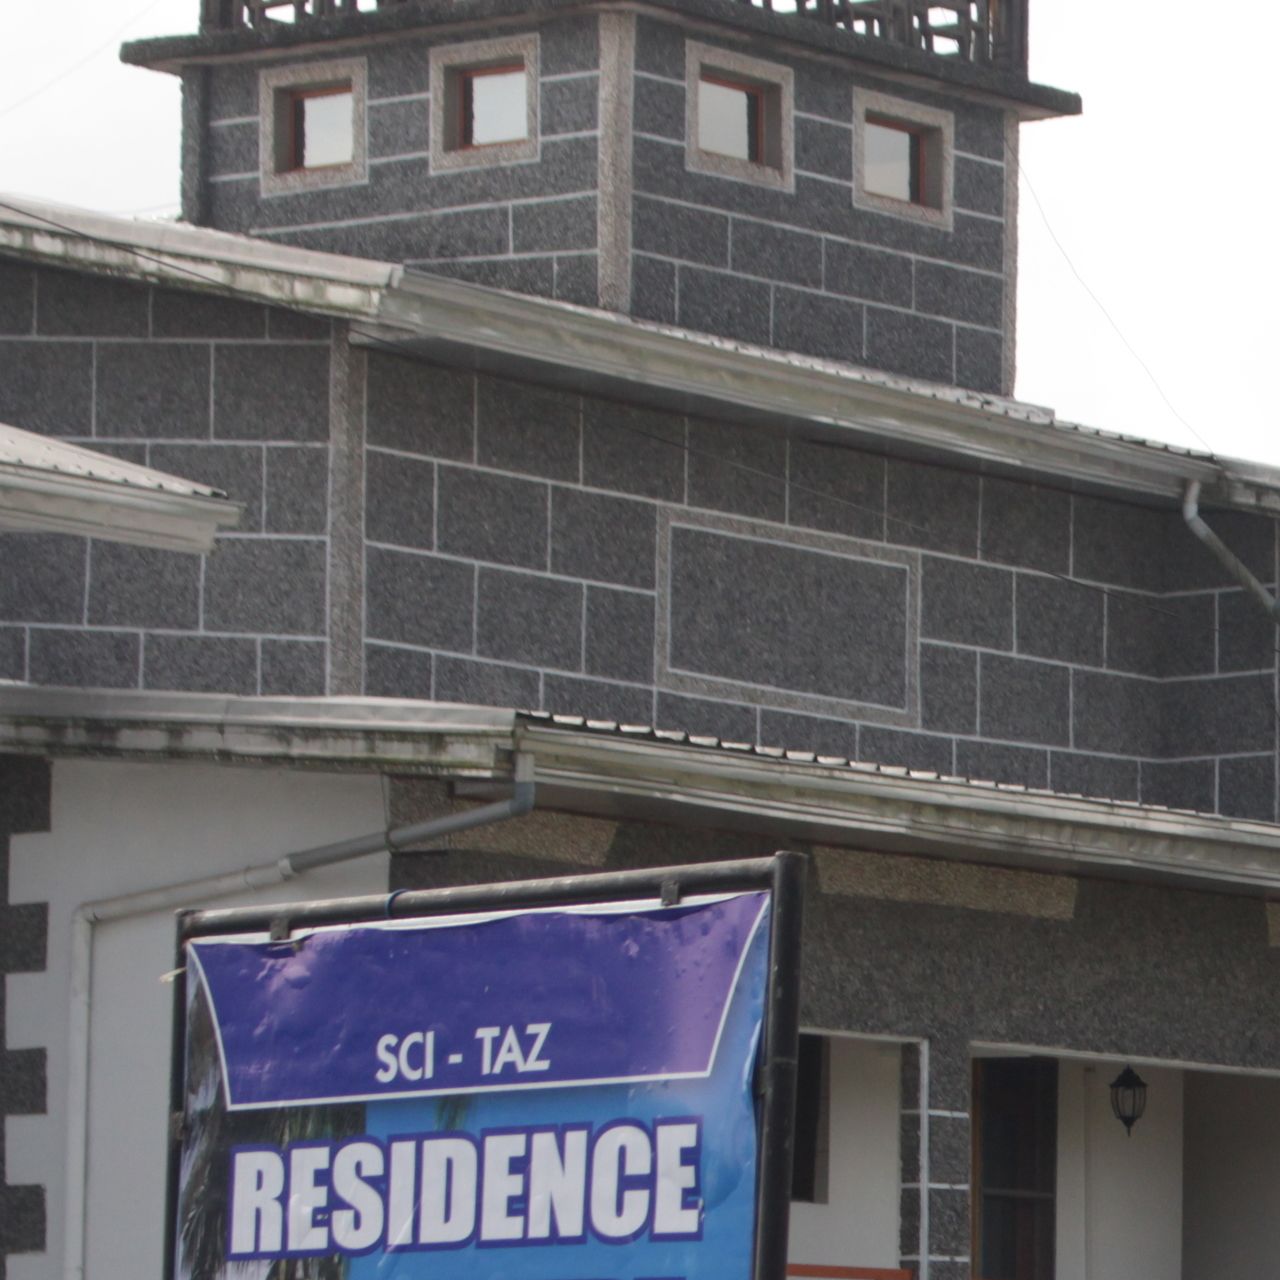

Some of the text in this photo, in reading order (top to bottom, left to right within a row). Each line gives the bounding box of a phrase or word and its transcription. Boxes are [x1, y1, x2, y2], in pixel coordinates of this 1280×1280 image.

[375, 1031, 434, 1083] SCI
[475, 1022, 552, 1076] TAZ
[226, 1115, 703, 1260] RESIDENCE
